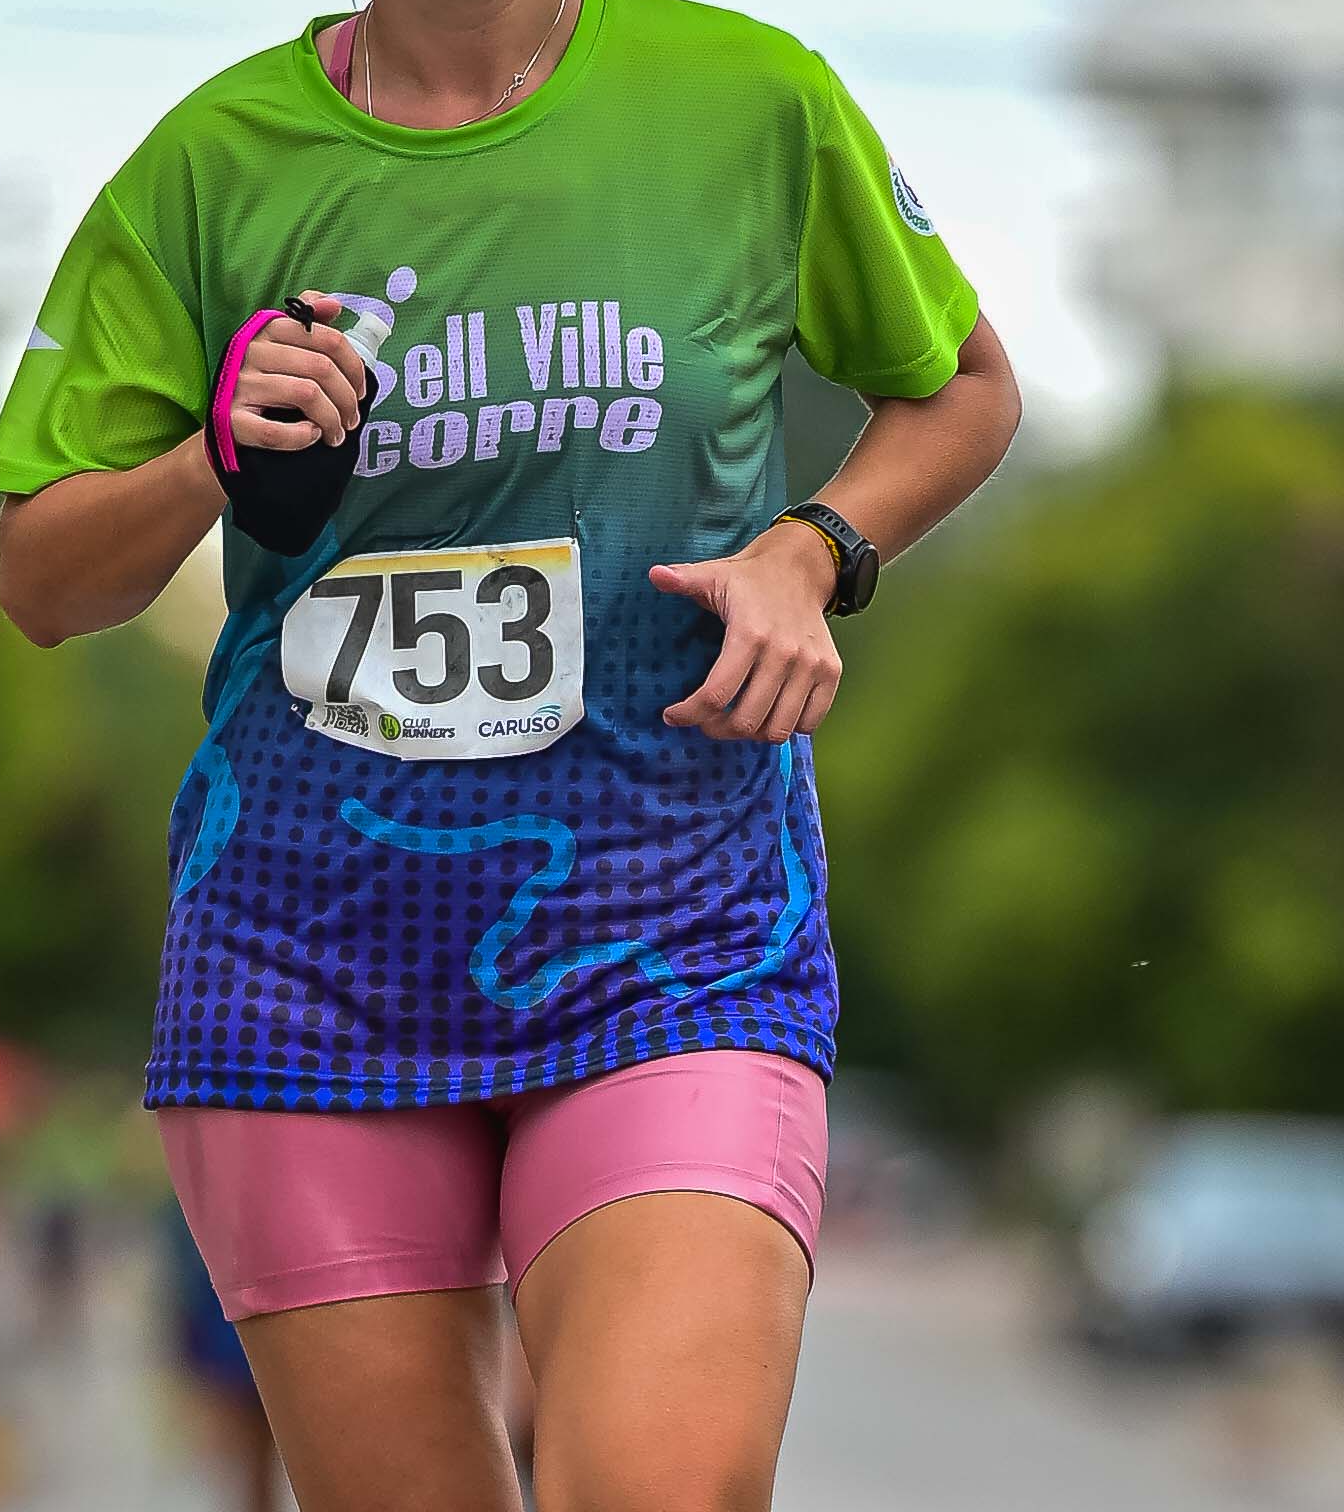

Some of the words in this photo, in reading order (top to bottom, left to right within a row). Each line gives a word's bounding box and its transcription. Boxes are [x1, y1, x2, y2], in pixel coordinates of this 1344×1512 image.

[515, 300, 664, 392] Ville
[353, 396, 662, 478] corre
[310, 565, 554, 705] 753
[402, 717, 431, 728] CLUB
[478, 715, 560, 738] CARUSO
